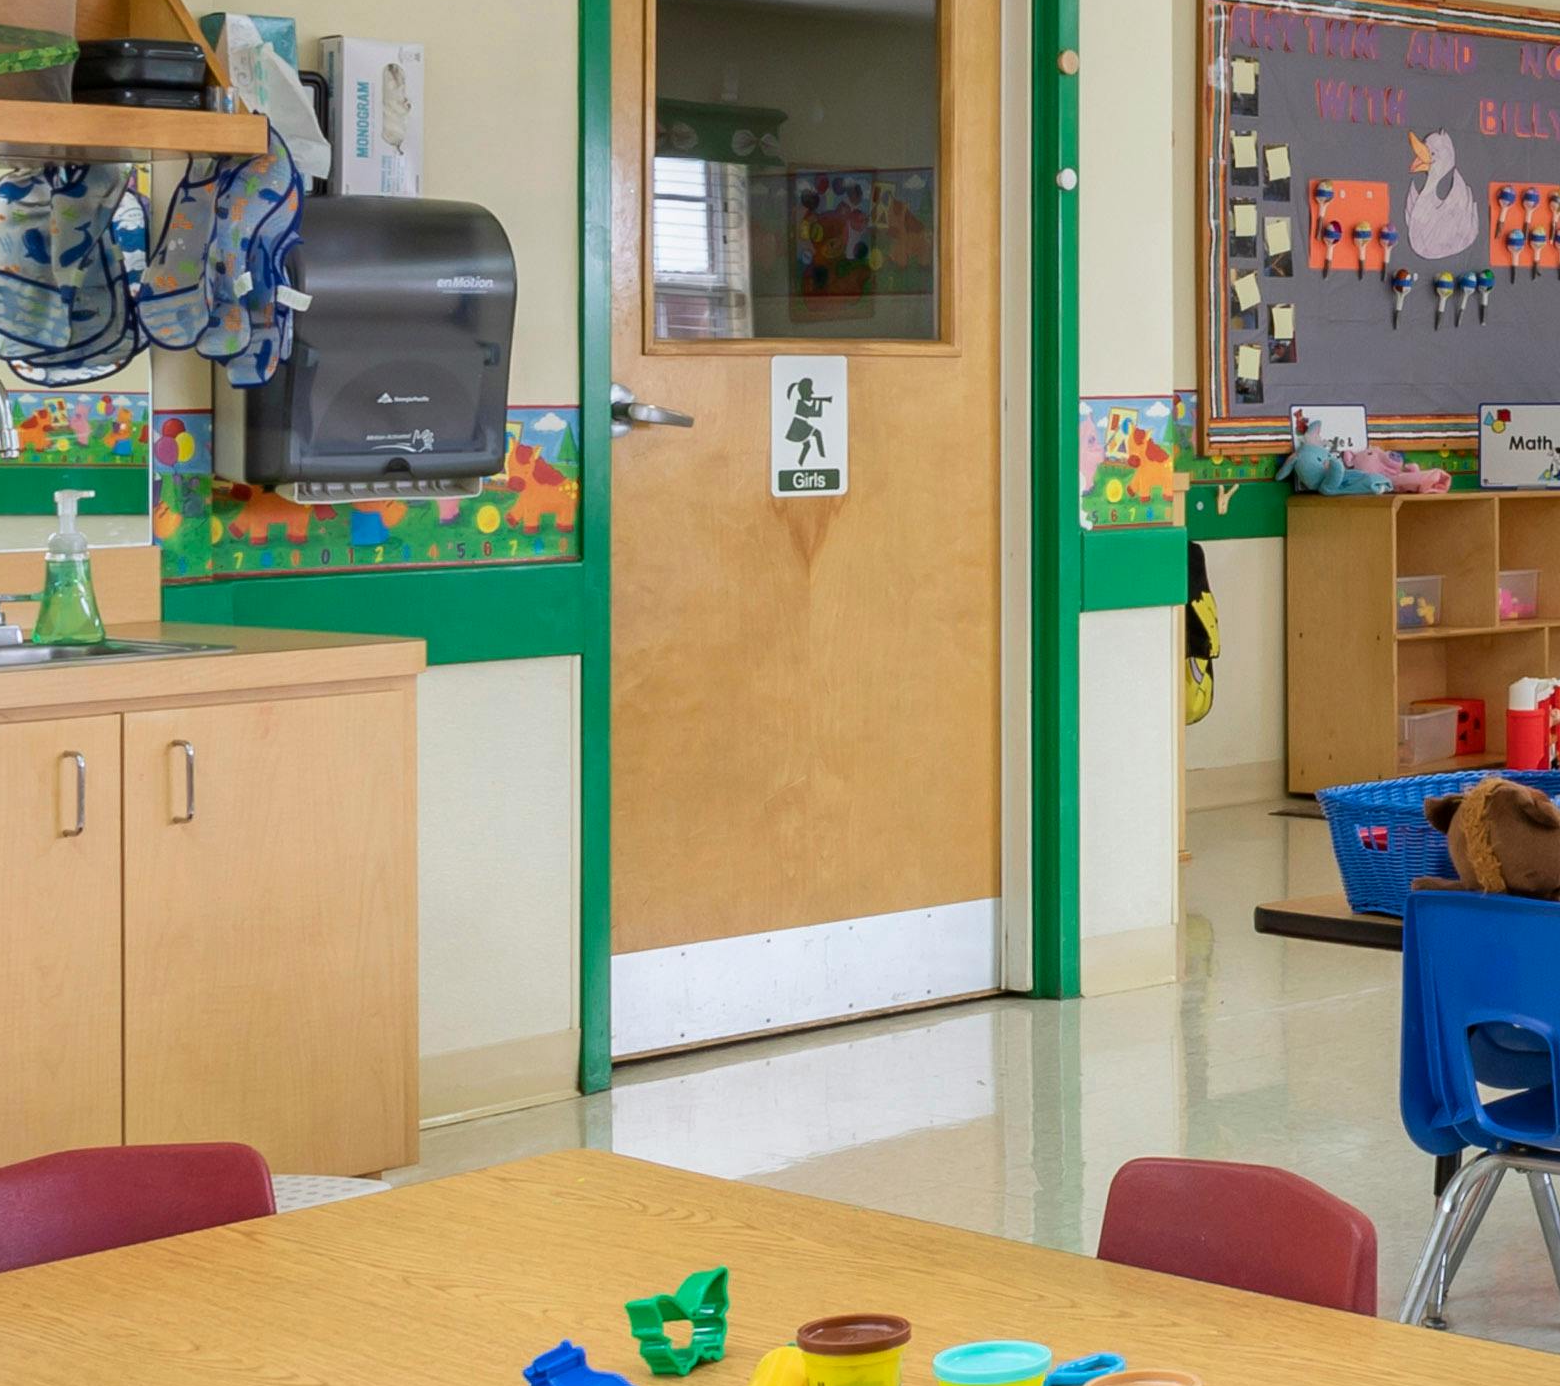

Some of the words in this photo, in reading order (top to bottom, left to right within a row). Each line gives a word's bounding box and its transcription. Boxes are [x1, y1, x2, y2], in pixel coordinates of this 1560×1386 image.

[1229, 4, 1382, 61] RHYTHM
[1404, 30, 1477, 74] AND
[1314, 76, 1408, 127] WITH
[356, 81, 370, 159] MONOGRAM
[436, 275, 494, 289] enMotion
[1508, 435, 1553, 451] Math
[792, 471, 827, 489] Girls
[233, 551, 244, 570] 7
[320, 548, 331, 565] 0
[373, 545, 384, 563] 2
[455, 542, 466, 559] 5
[508, 539, 519, 556] 7
